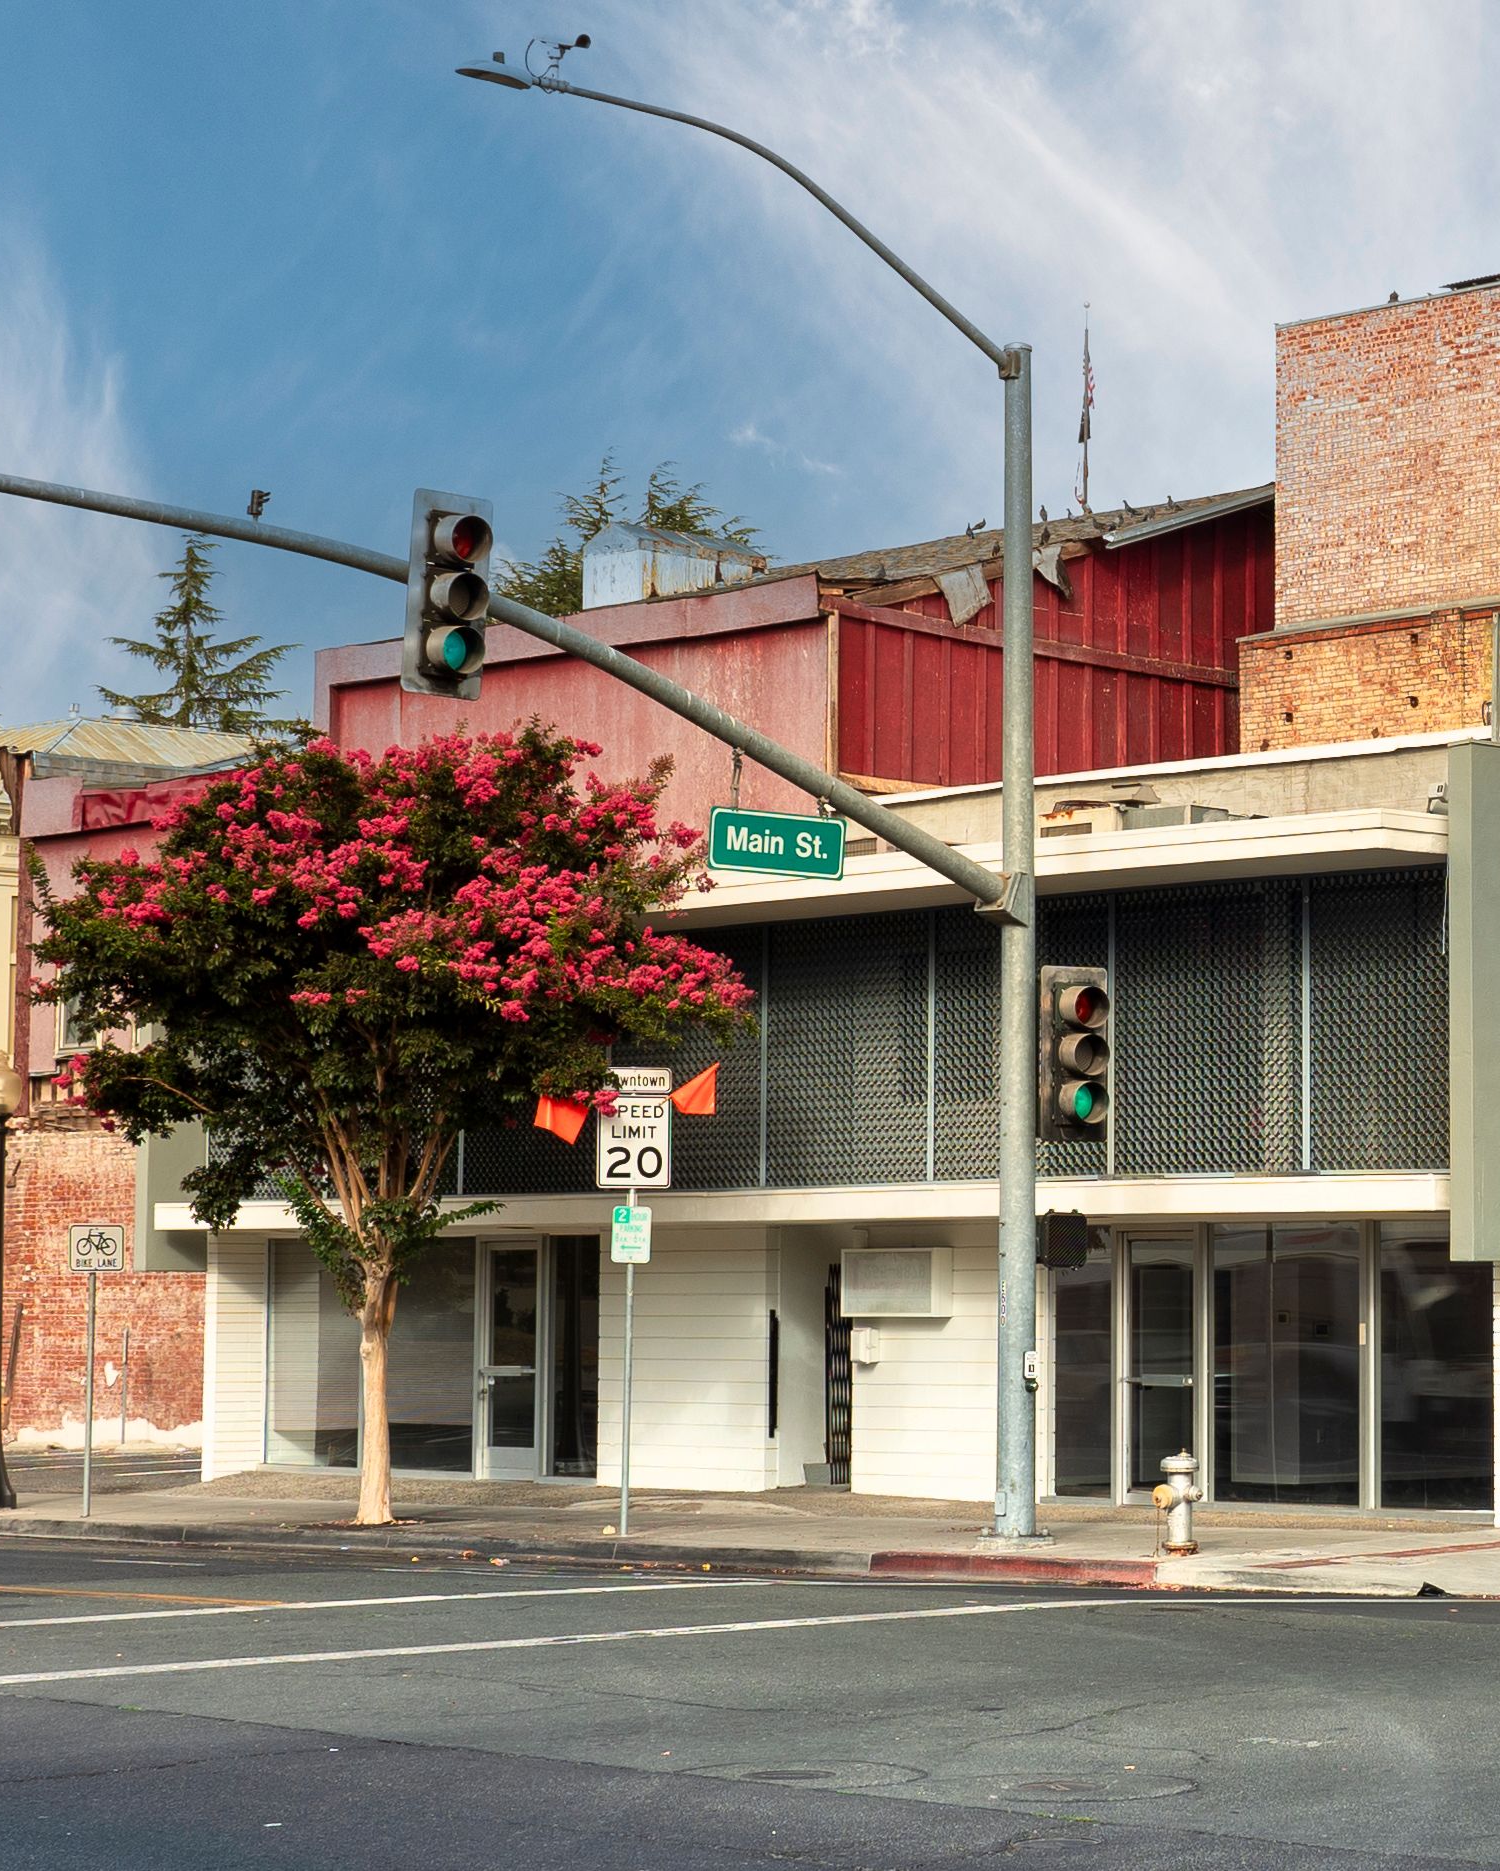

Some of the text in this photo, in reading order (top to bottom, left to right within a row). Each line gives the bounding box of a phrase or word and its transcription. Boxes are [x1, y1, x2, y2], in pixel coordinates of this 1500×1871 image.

[726, 826, 828, 860] Main St.
[616, 1105, 664, 1118] PEED
[611, 1126, 657, 1138] LIMIT
[606, 1146, 663, 1178] 20
[618, 1208, 627, 1222] 2
[75, 1258, 118, 1268] BIKE LANE
